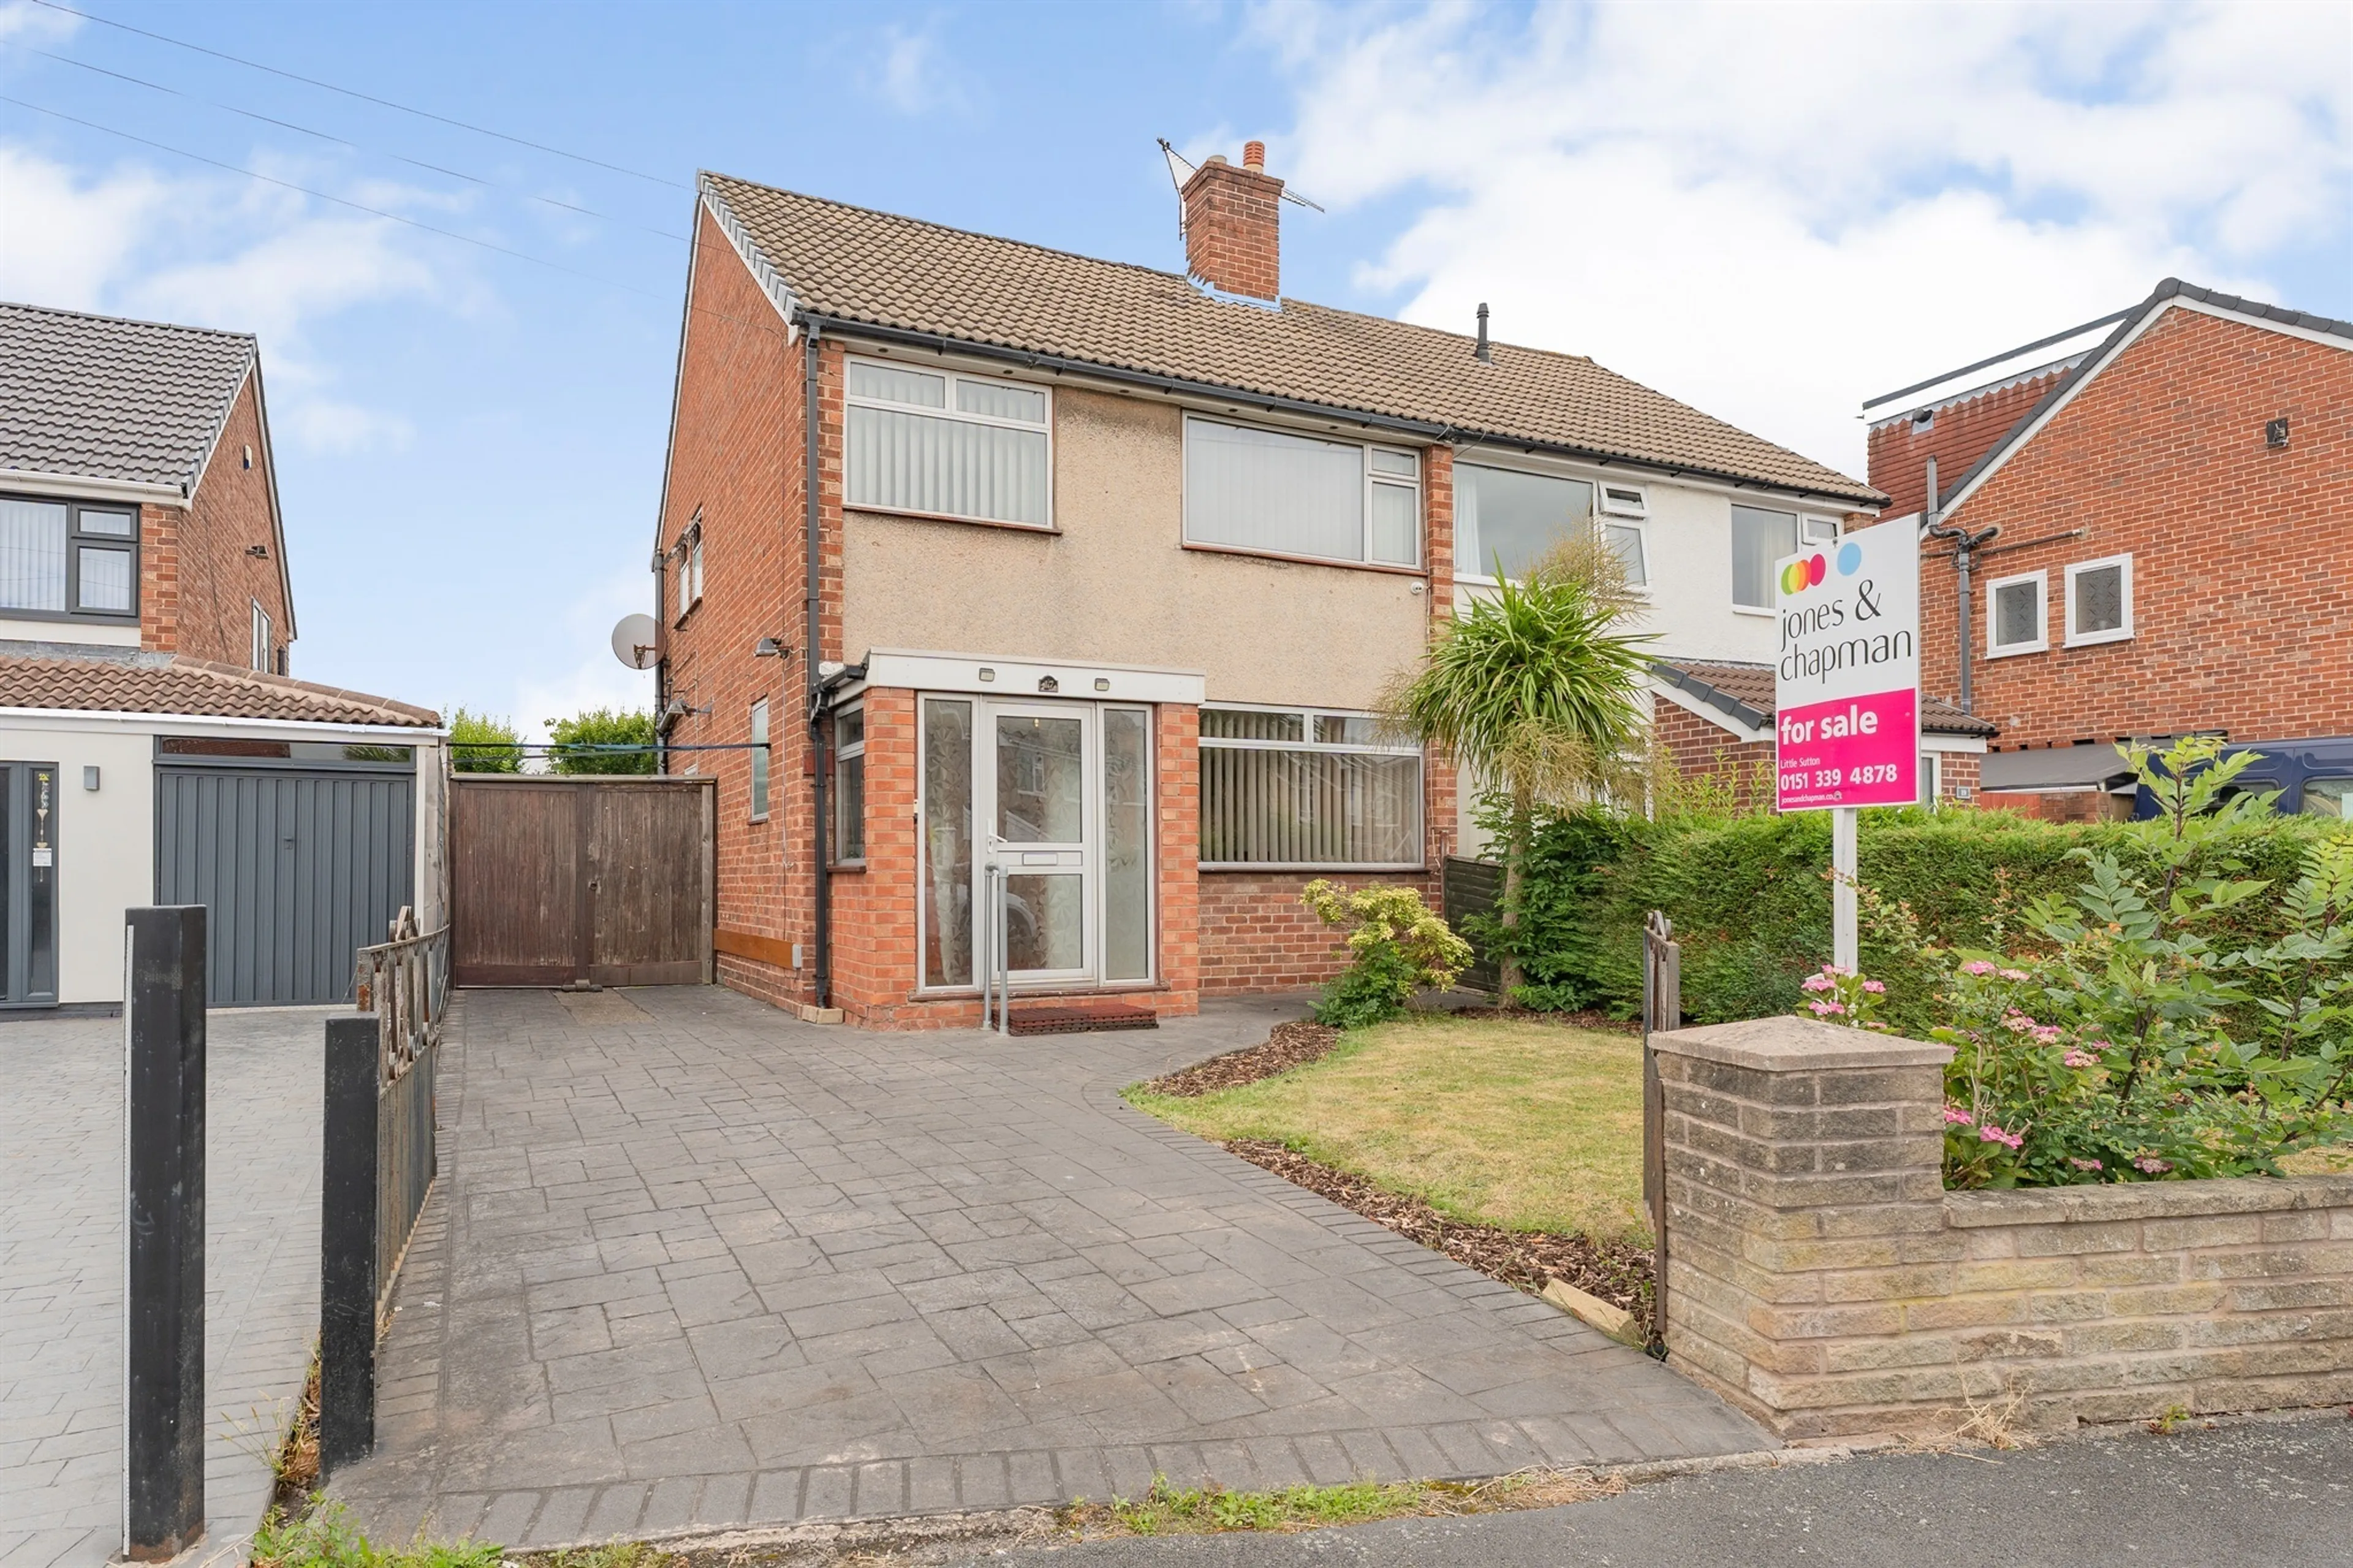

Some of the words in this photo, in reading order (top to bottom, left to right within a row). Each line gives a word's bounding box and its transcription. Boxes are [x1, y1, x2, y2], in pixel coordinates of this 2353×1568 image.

[1781, 599, 1844, 653] jones
[1855, 579, 1882, 621] &
[1781, 631, 1911, 684] chapman
[1781, 716, 1814, 745] for
[1821, 704, 1878, 740] sale
[1780, 758, 1798, 769] Little
[1799, 757, 1821, 767] Sutton
[1781, 772, 1808, 791] 0151
[1815, 768, 1841, 788] 339
[1849, 763, 1898, 785] 4878
